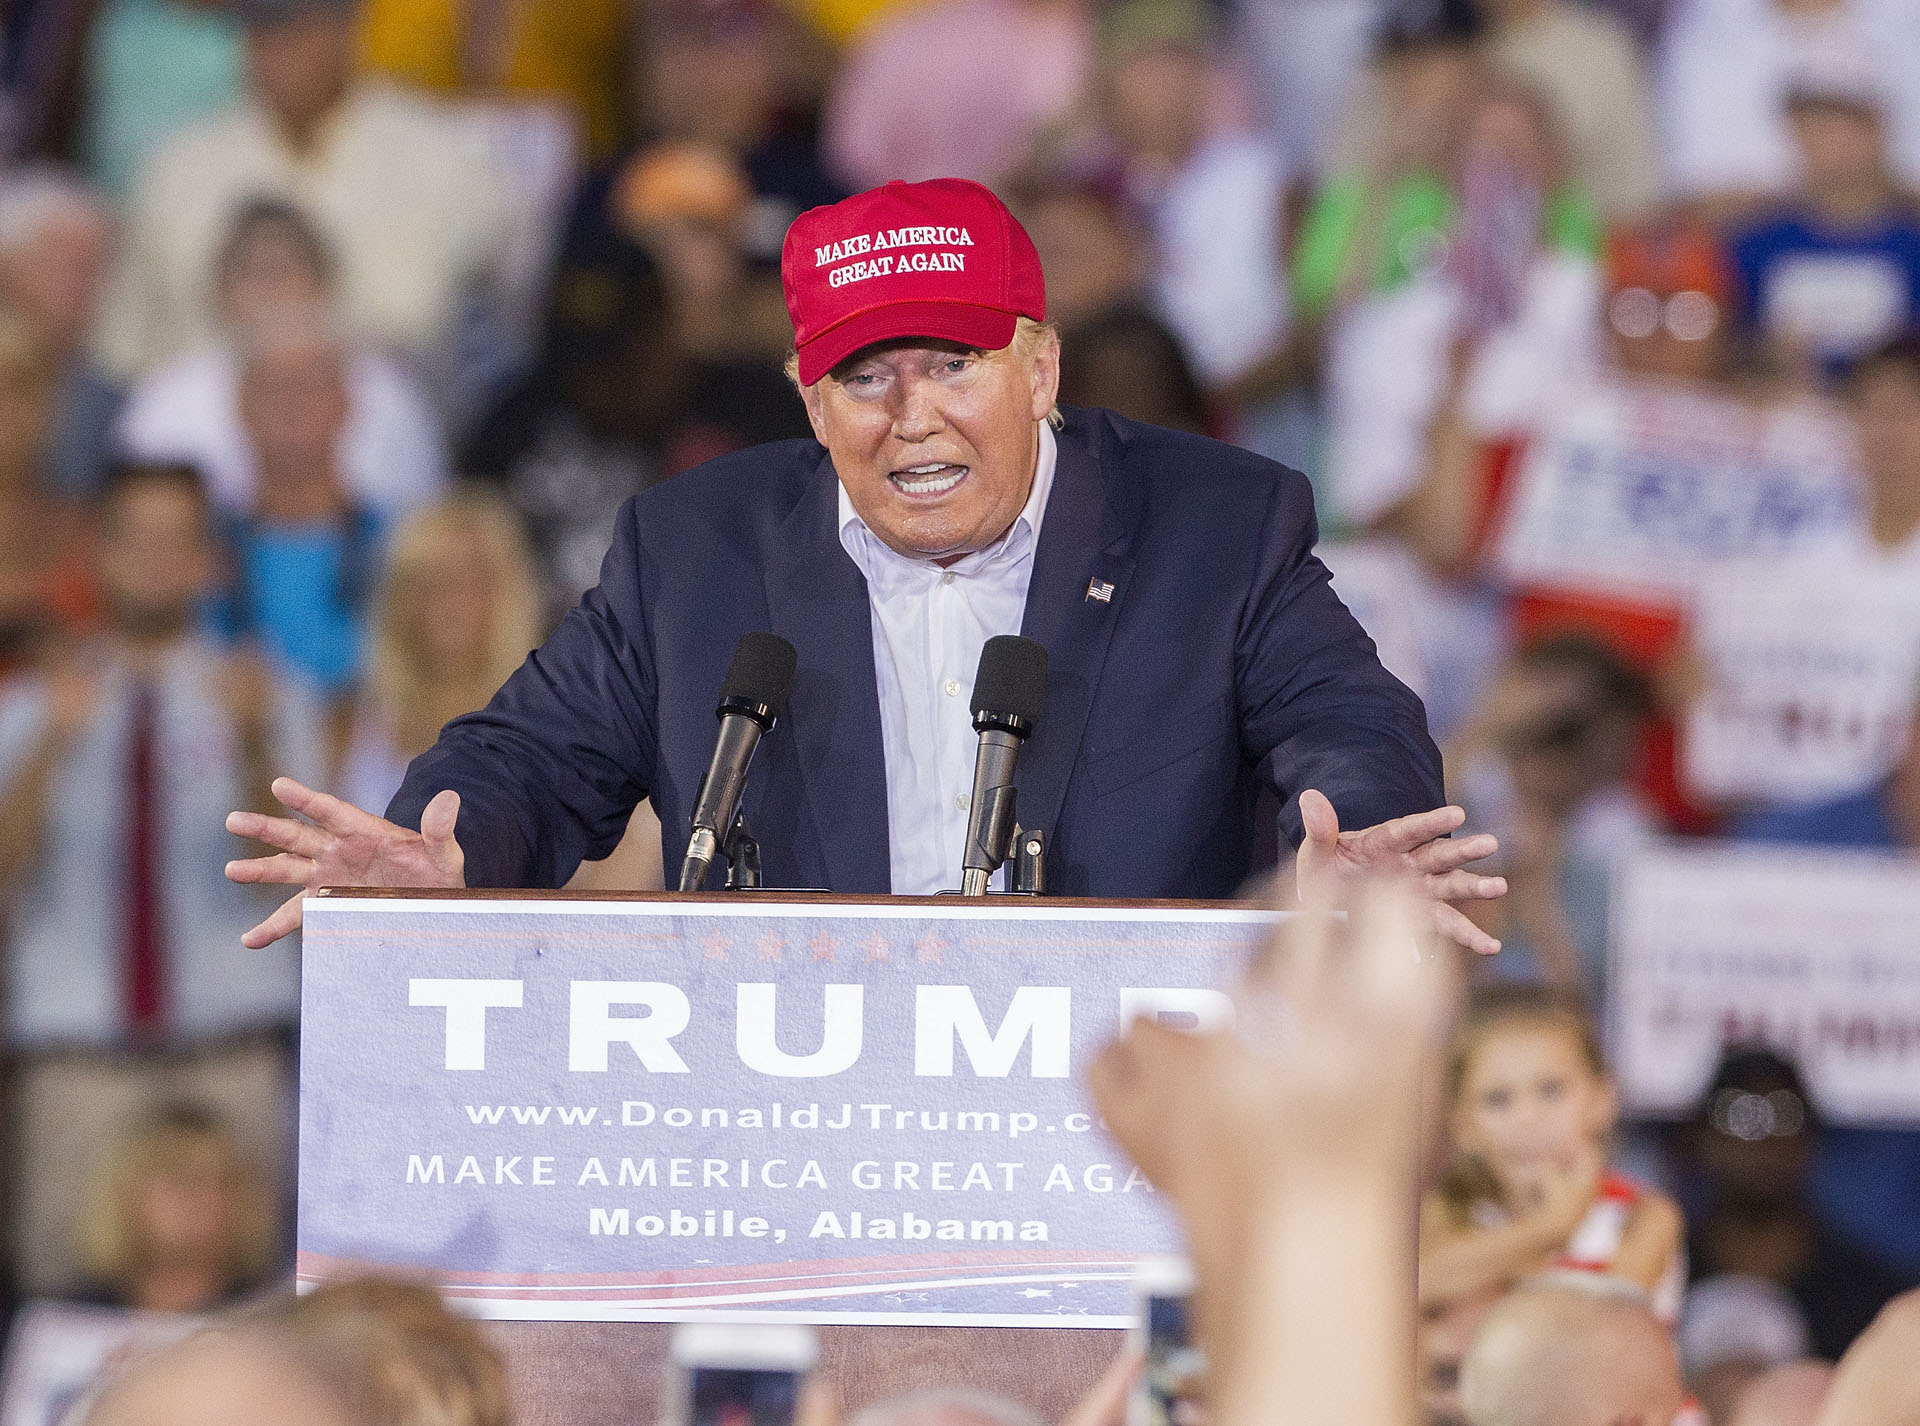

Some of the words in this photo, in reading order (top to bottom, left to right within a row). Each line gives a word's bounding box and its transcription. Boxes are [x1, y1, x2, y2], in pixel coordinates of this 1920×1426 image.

[815, 234, 871, 267] MAKE
[872, 226, 974, 251] AMERICA
[828, 256, 894, 288] GREAT
[895, 253, 964, 273] AGAIN
[464, 1100, 1110, 1139] www.DonaldJTrump.c
[406, 1154, 557, 1186] MAKE
[577, 1156, 829, 1190] AMERICA
[850, 1160, 1025, 1193] GREAT
[1042, 1162, 1155, 1194] AGA
[588, 1207, 787, 1244] Mobile,
[808, 1211, 1049, 1242] Alabama
